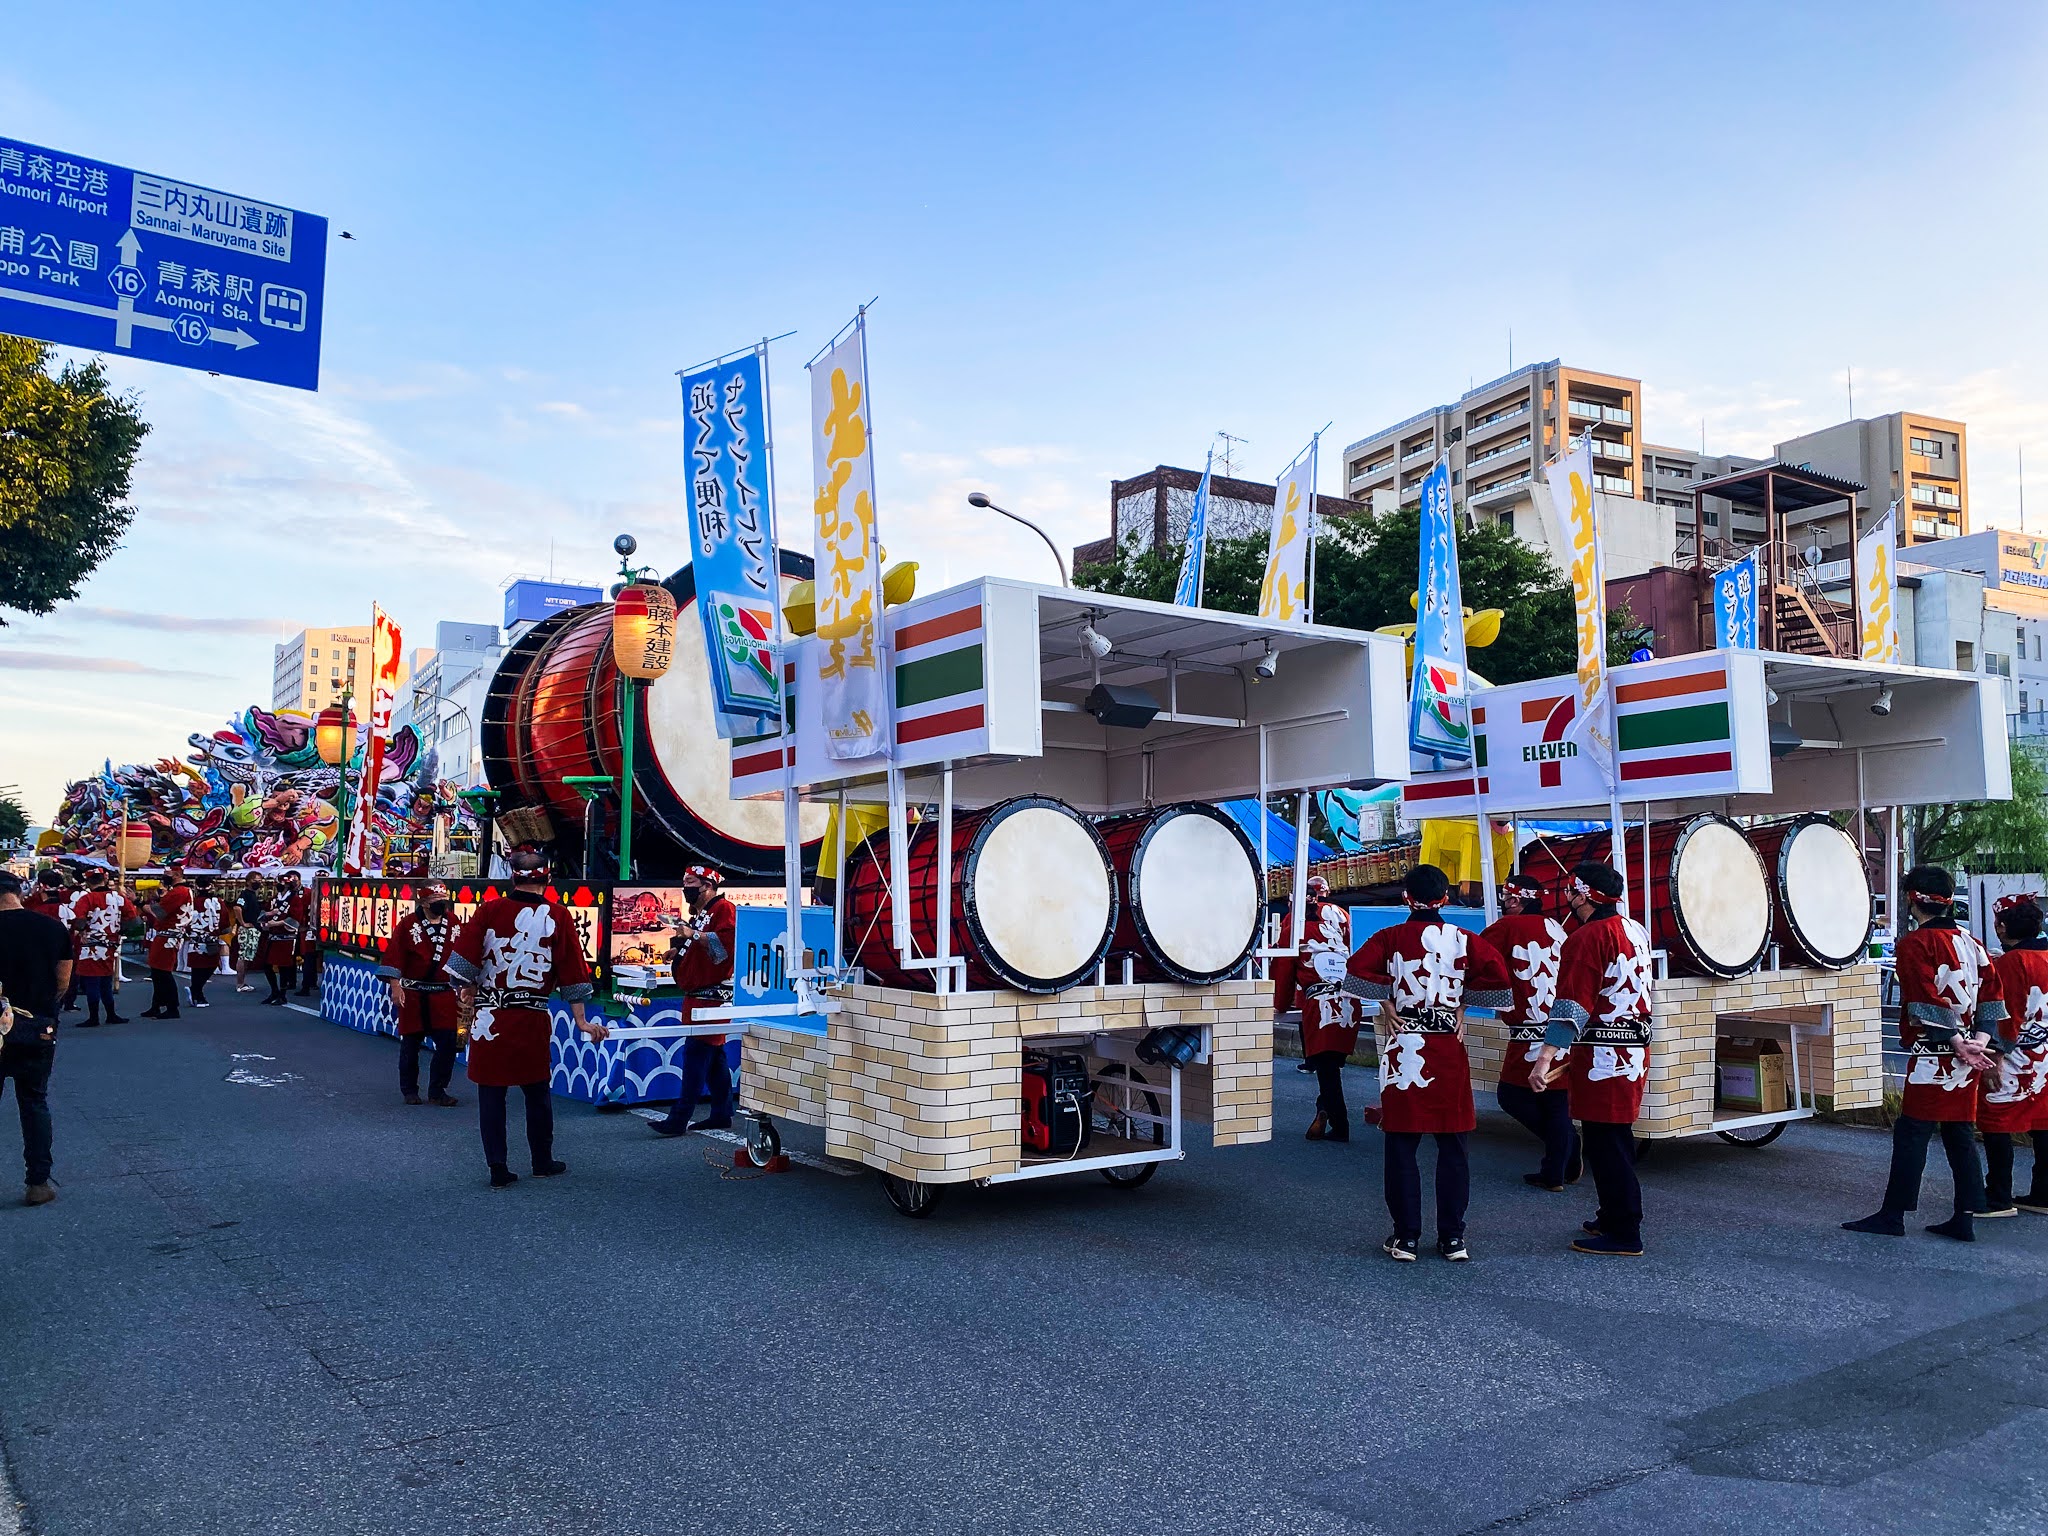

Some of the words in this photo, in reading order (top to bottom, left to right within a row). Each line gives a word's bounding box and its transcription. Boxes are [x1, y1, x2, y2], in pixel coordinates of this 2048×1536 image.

[0, 147, 108, 197] 青森空港
[0, 178, 51, 203] Aomori
[57, 191, 108, 216] Airport
[137, 180, 288, 238] 三内丸山遺跡
[262, 239, 286, 257] Site
[39, 265, 80, 287] Park
[115, 269, 138, 293] 16
[157, 260, 253, 304] 青森駅
[155, 290, 215, 315] Aomori
[222, 303, 252, 322] Sta.
[178, 319, 202, 340] 16
[642, 605, 673, 669] 藤本建設
[1595, 1030, 1638, 1040] FUJIMOTO
